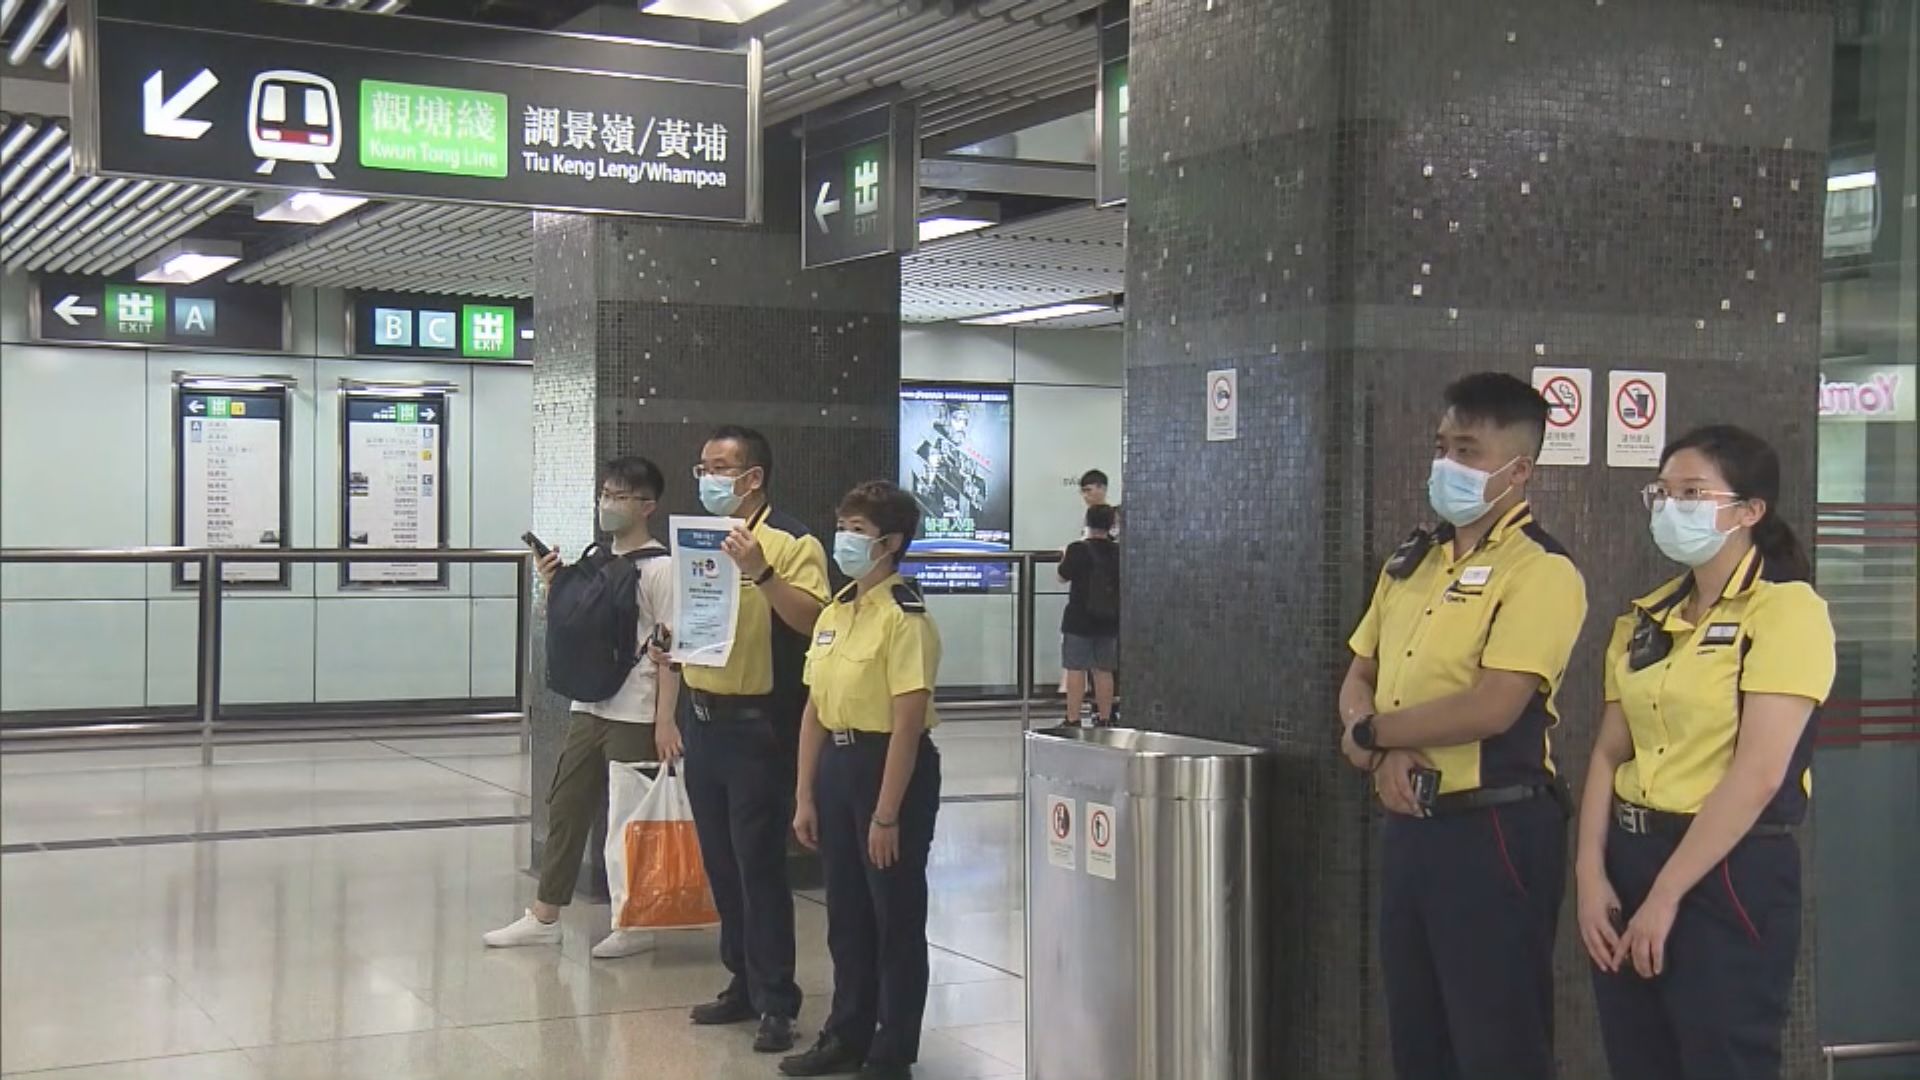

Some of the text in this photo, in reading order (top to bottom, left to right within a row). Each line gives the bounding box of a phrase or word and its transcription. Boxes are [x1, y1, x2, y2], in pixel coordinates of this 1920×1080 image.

[369, 139, 498, 170] Kwun Tong Line
[521, 151, 727, 189] Tiu Keng Leng/Whampoa
[854, 159, 879, 216] 出
[118, 292, 154, 322] 出
[184, 305, 206, 332] A
[118, 322, 153, 333] EXIT
[385, 315, 447, 343] B C
[472, 311, 505, 340] 出
[472, 339, 504, 351] EXIT
